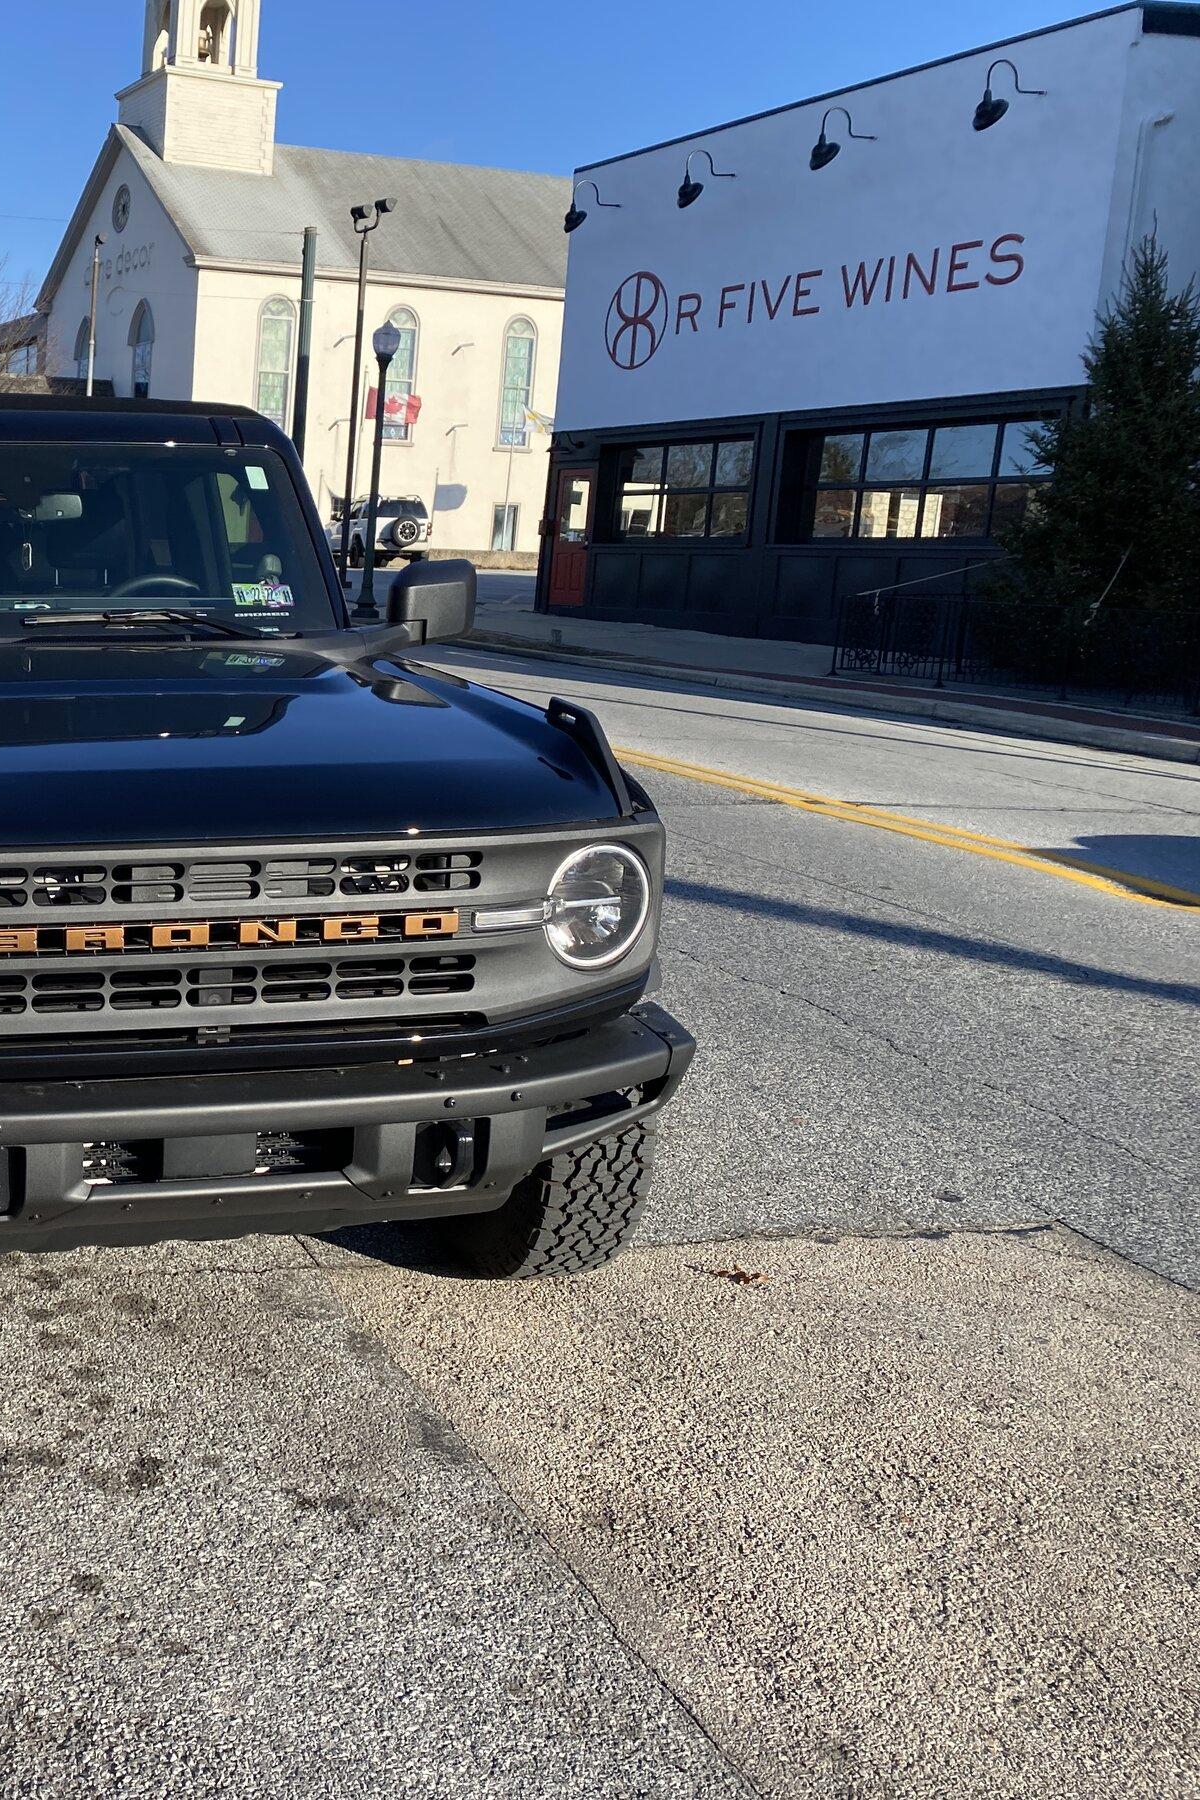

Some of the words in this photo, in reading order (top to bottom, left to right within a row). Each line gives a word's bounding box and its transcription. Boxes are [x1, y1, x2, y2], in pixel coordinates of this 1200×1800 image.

[675, 293, 701, 335] R
[718, 269, 823, 328] FIVE
[841, 233, 1025, 308] WINES
